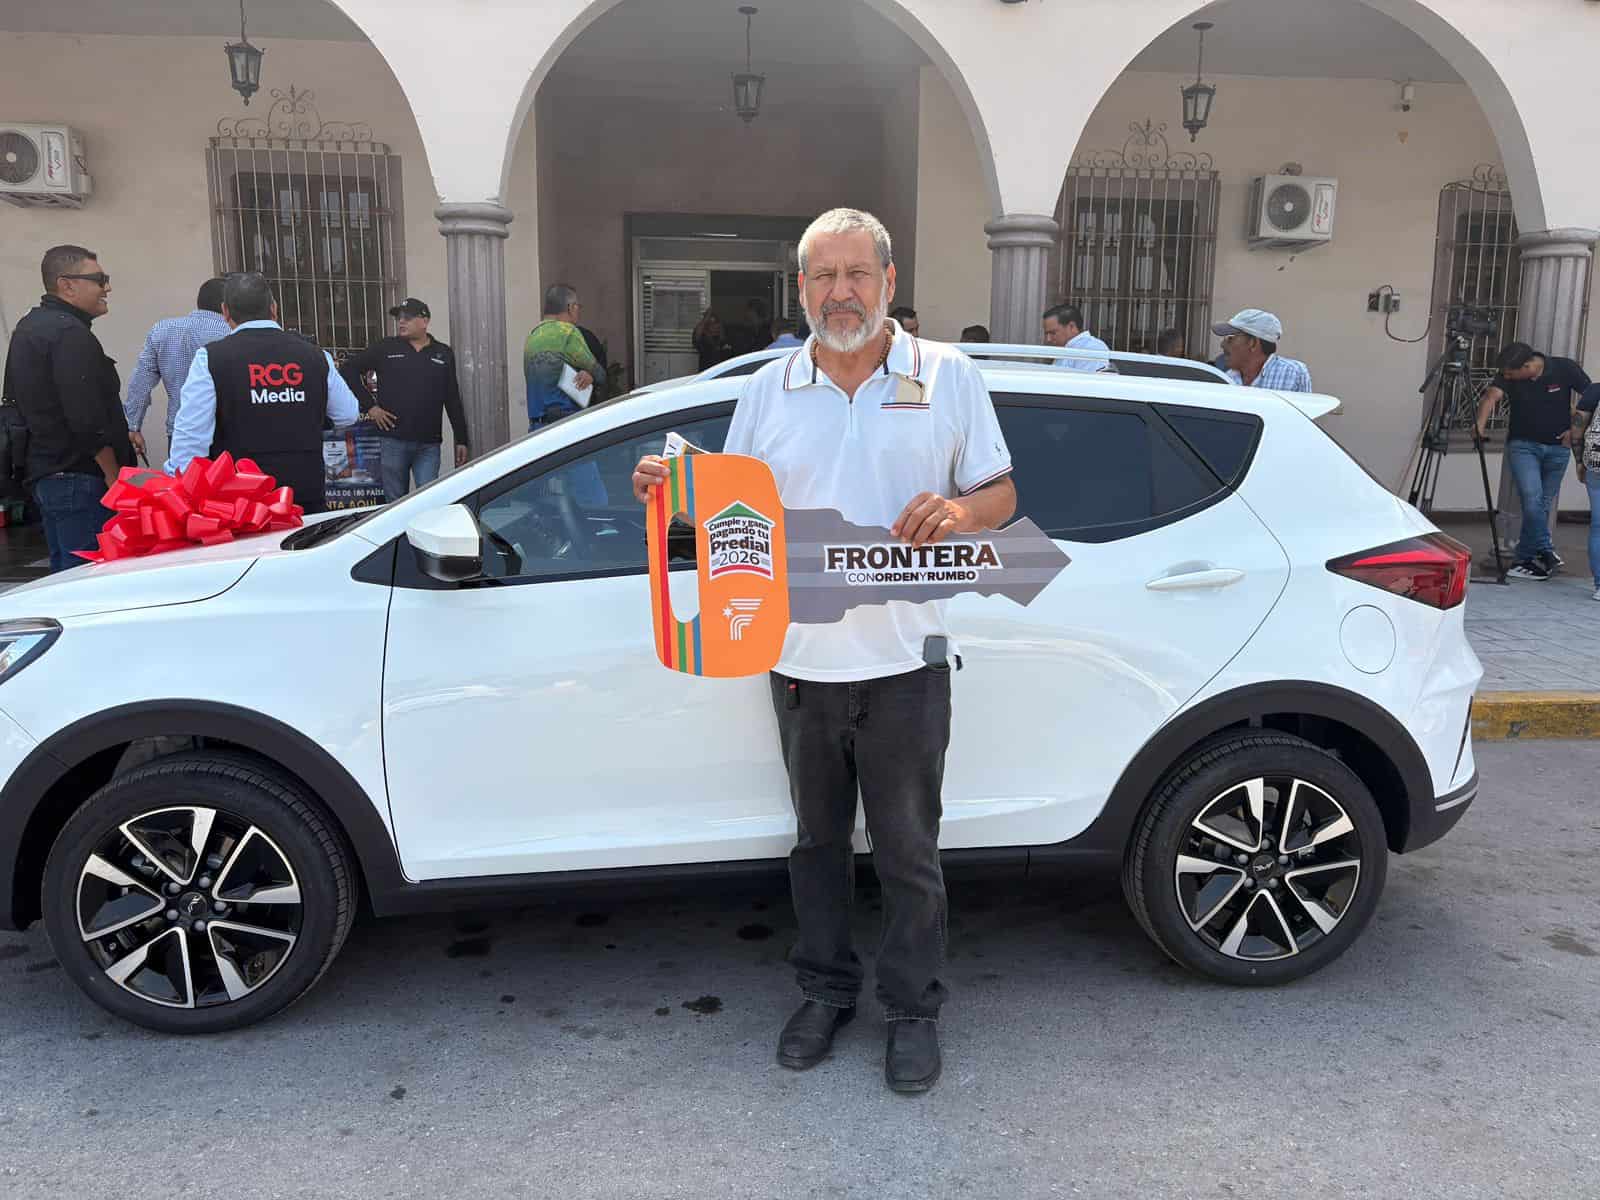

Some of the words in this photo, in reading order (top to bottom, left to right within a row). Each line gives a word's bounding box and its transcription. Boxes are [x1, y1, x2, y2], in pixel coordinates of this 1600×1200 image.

[248, 363, 304, 387] RCG
[250, 387, 305, 404] Media
[342, 489, 351, 497] DE
[709, 518, 741, 531] Cumple
[748, 519, 769, 531] gana
[710, 526, 756, 543] pagando
[757, 529, 769, 540] tu
[711, 536, 770, 556] Predial
[719, 550, 761, 566] 2026
[827, 544, 998, 570] FRONTERA
